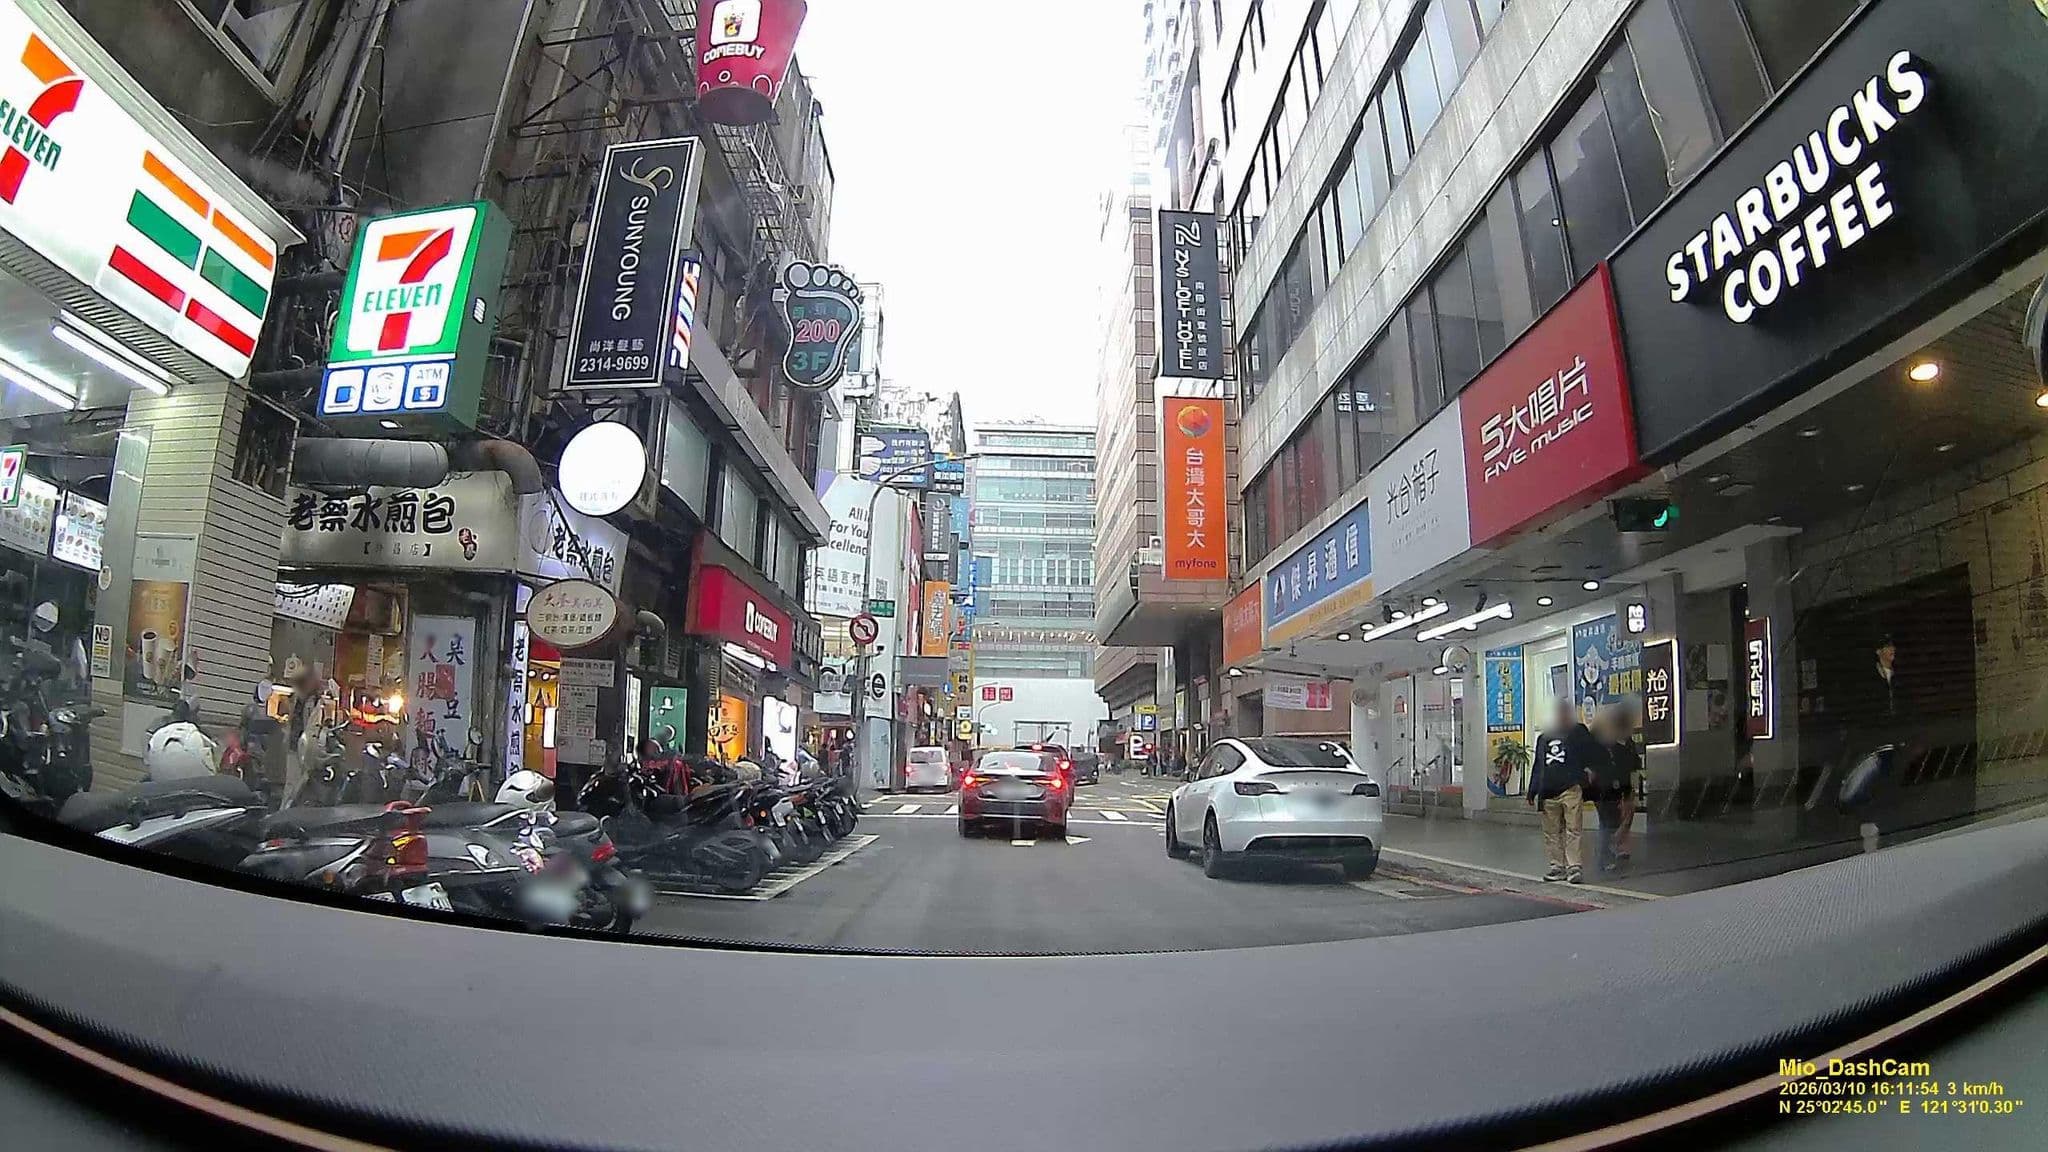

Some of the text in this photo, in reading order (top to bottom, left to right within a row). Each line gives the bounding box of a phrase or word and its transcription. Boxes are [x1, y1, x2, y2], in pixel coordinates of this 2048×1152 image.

[703, 43, 765, 64] COMEBUY
[1666, 50, 1926, 302] STARBUCKS
[612, 195, 649, 321] SUNYOUNG
[1722, 161, 1894, 324] COFFEE
[1175, 279, 1192, 318] LOFT
[795, 319, 840, 343] 200
[1176, 320, 1193, 370] HOTEL
[579, 355, 649, 372] 2314-9699
[792, 351, 829, 371] 3F
[1480, 355, 1589, 463] 5大唱片
[1484, 450, 1528, 484] FIVE
[848, 506, 863, 521] All
[1184, 447, 1206, 548] 台灣大哥大
[829, 519, 848, 534] For
[1175, 558, 1217, 570] myfone
[1749, 639, 1764, 717] 5大唱片
